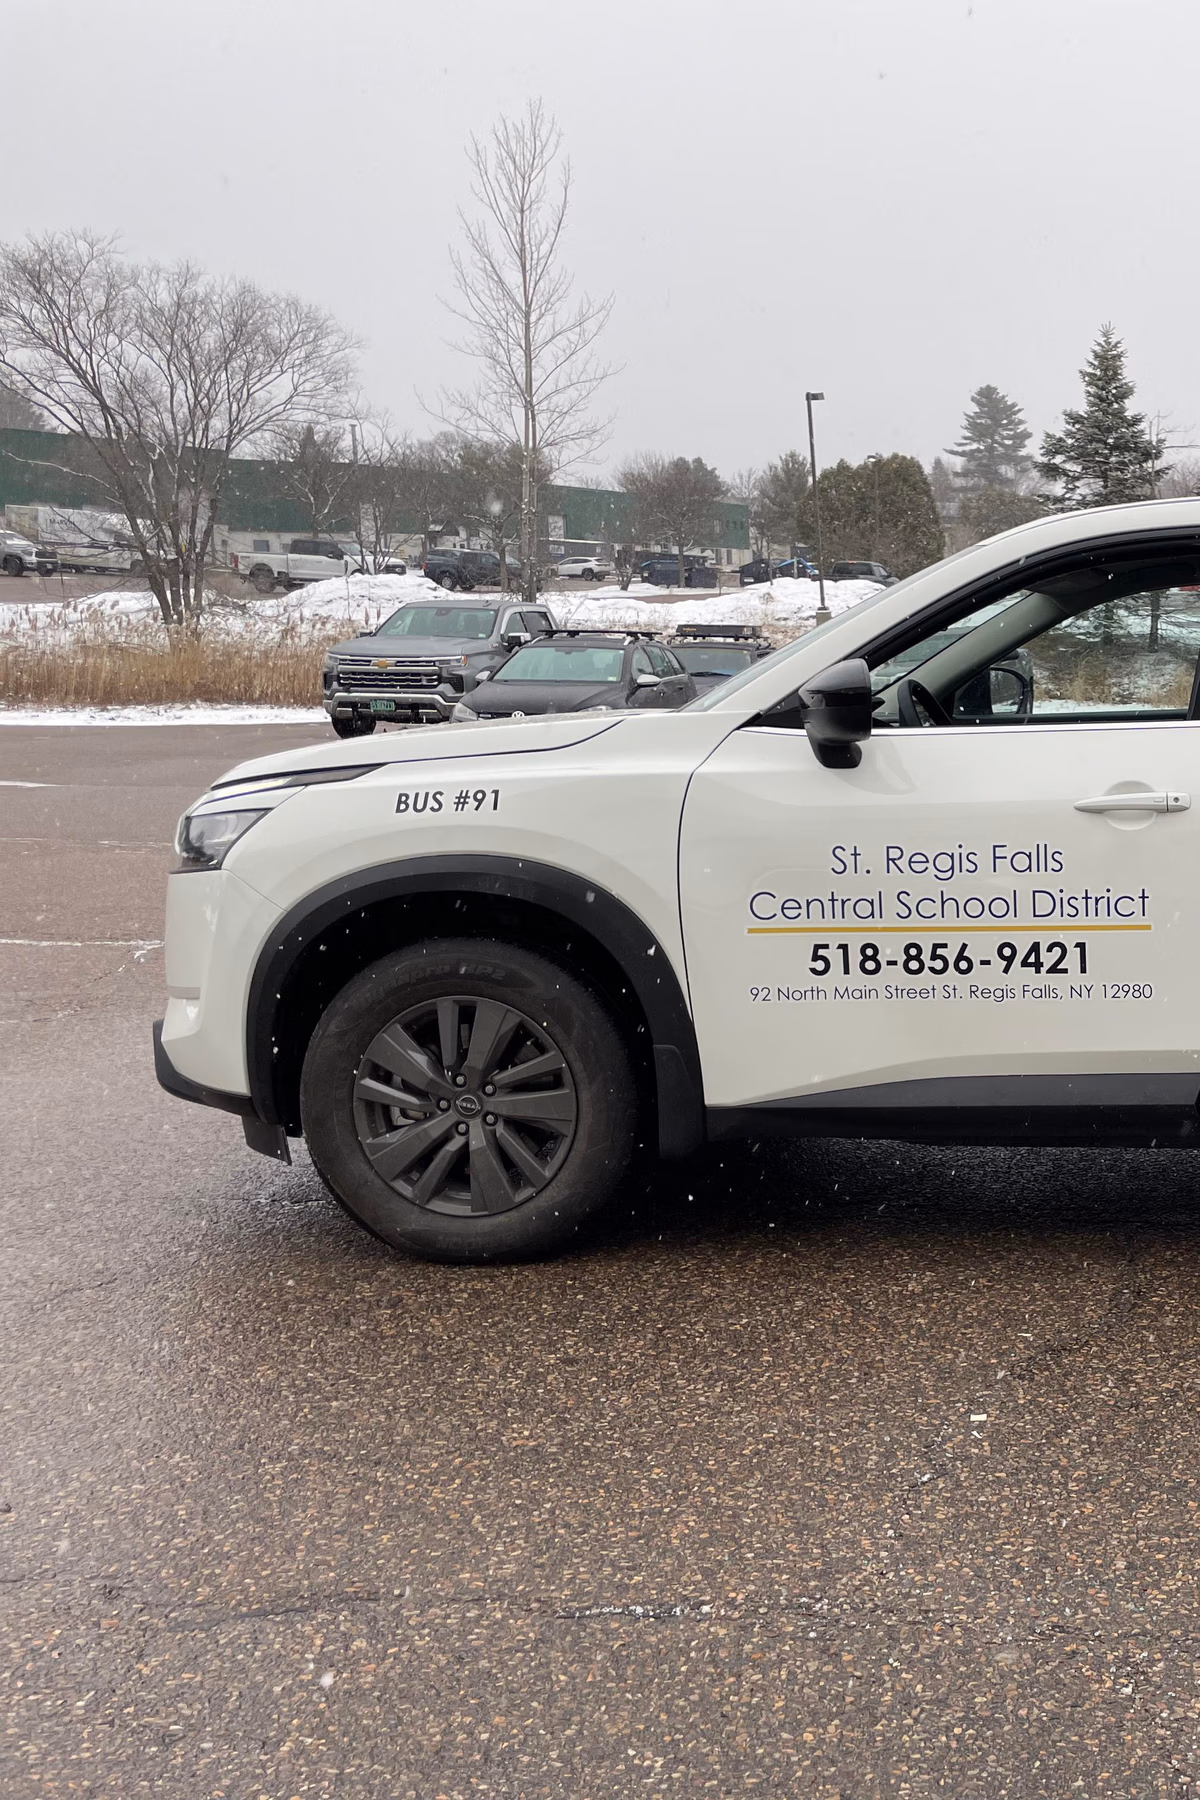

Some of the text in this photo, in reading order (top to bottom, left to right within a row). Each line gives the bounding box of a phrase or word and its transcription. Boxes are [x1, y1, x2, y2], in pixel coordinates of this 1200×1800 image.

[395, 788, 500, 814] BUS #91
[830, 843, 1064, 882] St. Regis Falls
[749, 888, 1150, 921] Central School District
[808, 941, 1087, 976] 518-856-9421
[749, 983, 1153, 1003] 92 North Main Street St. Regis Falls, NY 12980
